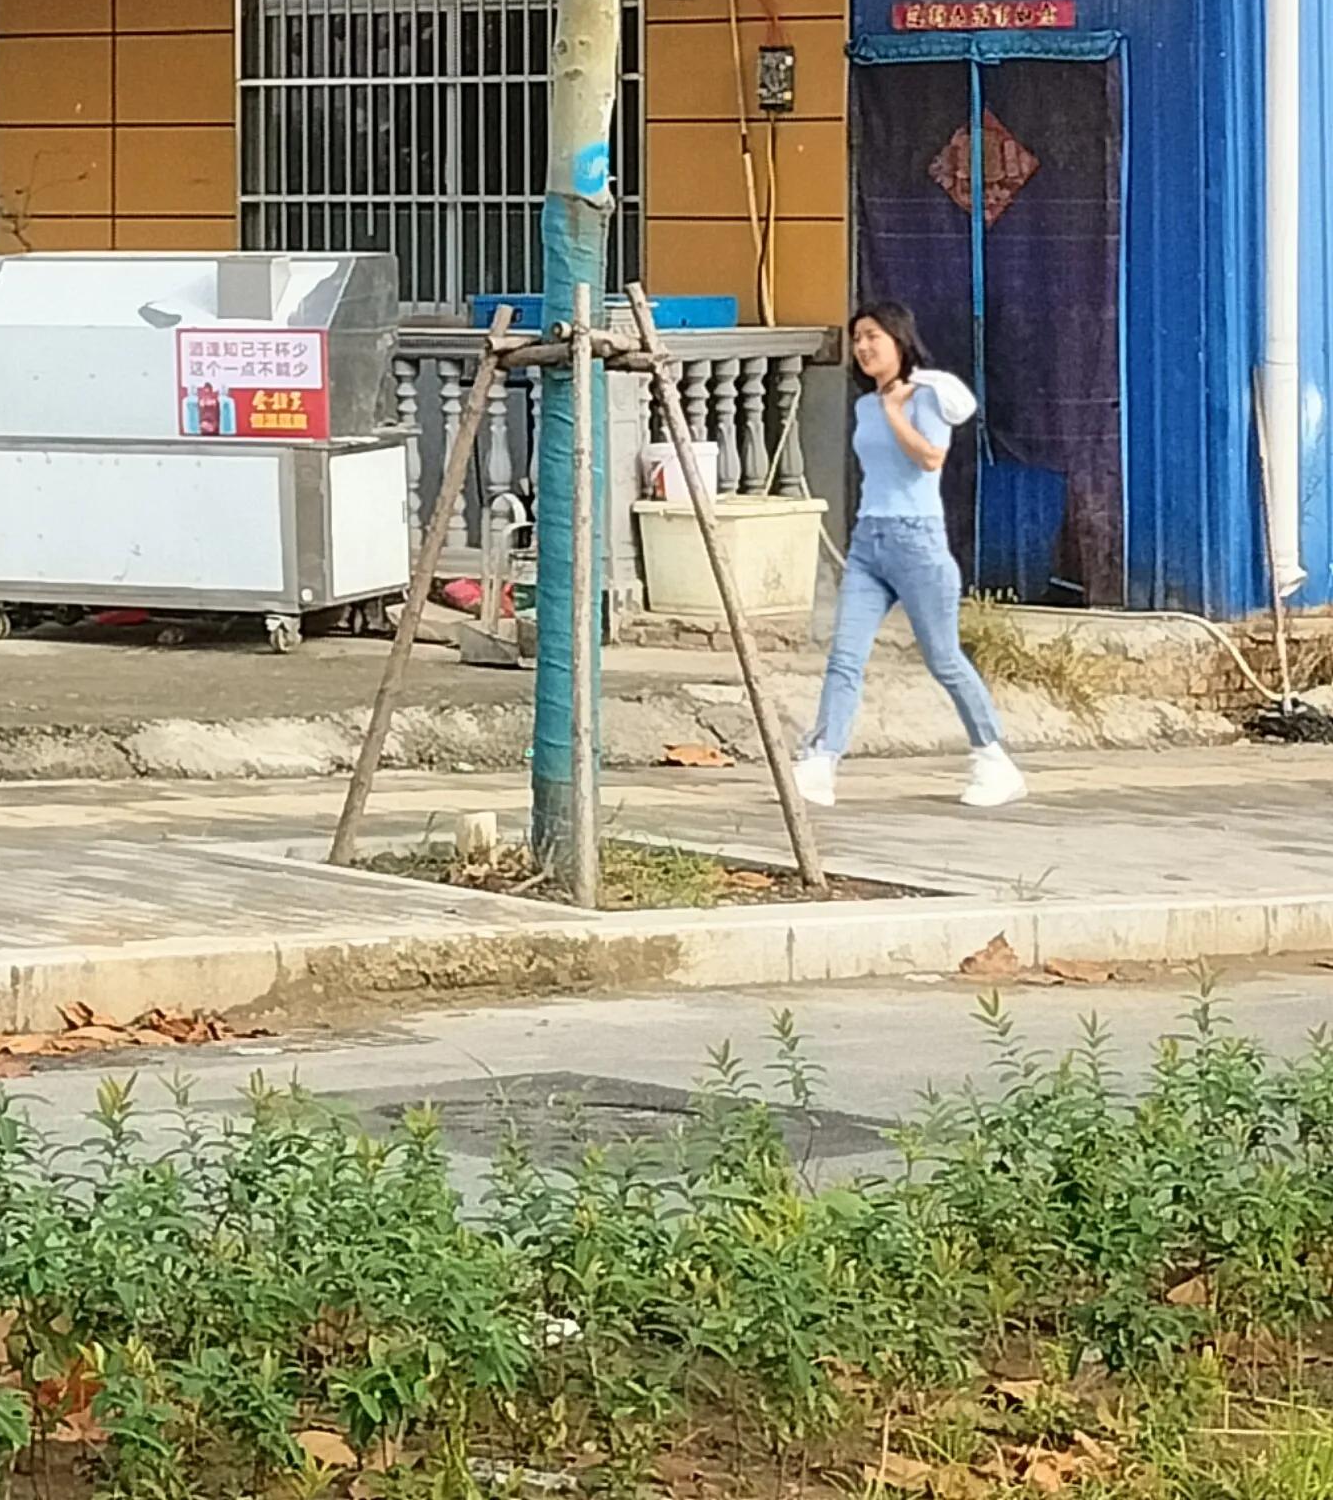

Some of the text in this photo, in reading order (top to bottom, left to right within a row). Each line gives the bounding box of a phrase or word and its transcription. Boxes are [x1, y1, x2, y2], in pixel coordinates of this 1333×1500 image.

[189, 341, 309, 357] 酒逢知己千杯少
